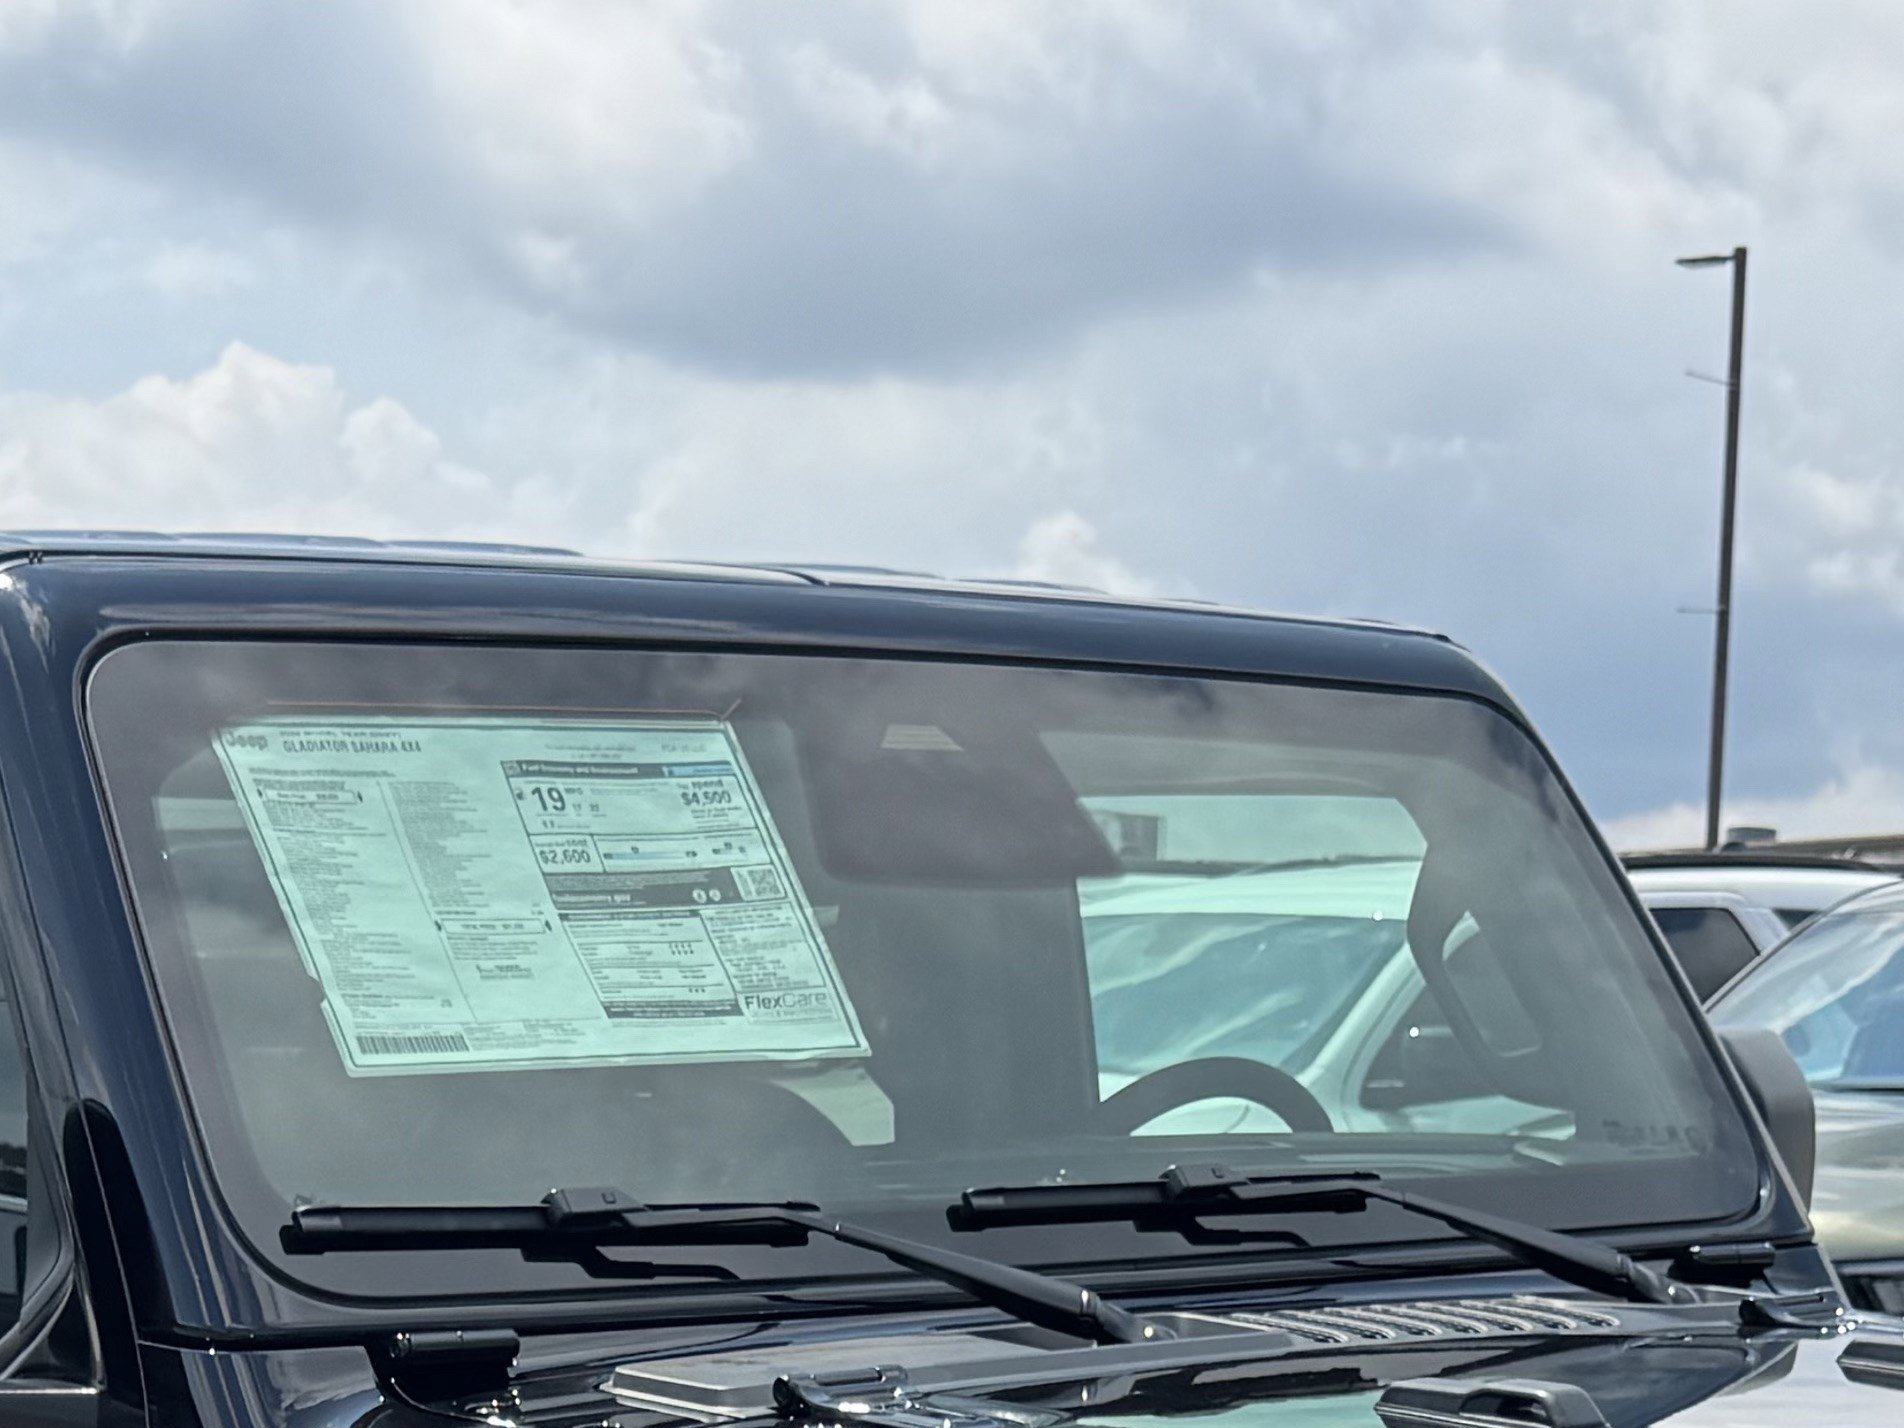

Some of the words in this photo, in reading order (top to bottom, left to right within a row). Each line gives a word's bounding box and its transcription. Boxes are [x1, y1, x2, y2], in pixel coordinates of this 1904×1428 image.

[283, 740, 349, 753] GLADIATOR
[531, 786, 566, 812] 19
[681, 790, 732, 807] $4,500
[539, 849, 592, 865] $2,600
[745, 991, 828, 1010] FlexCare
